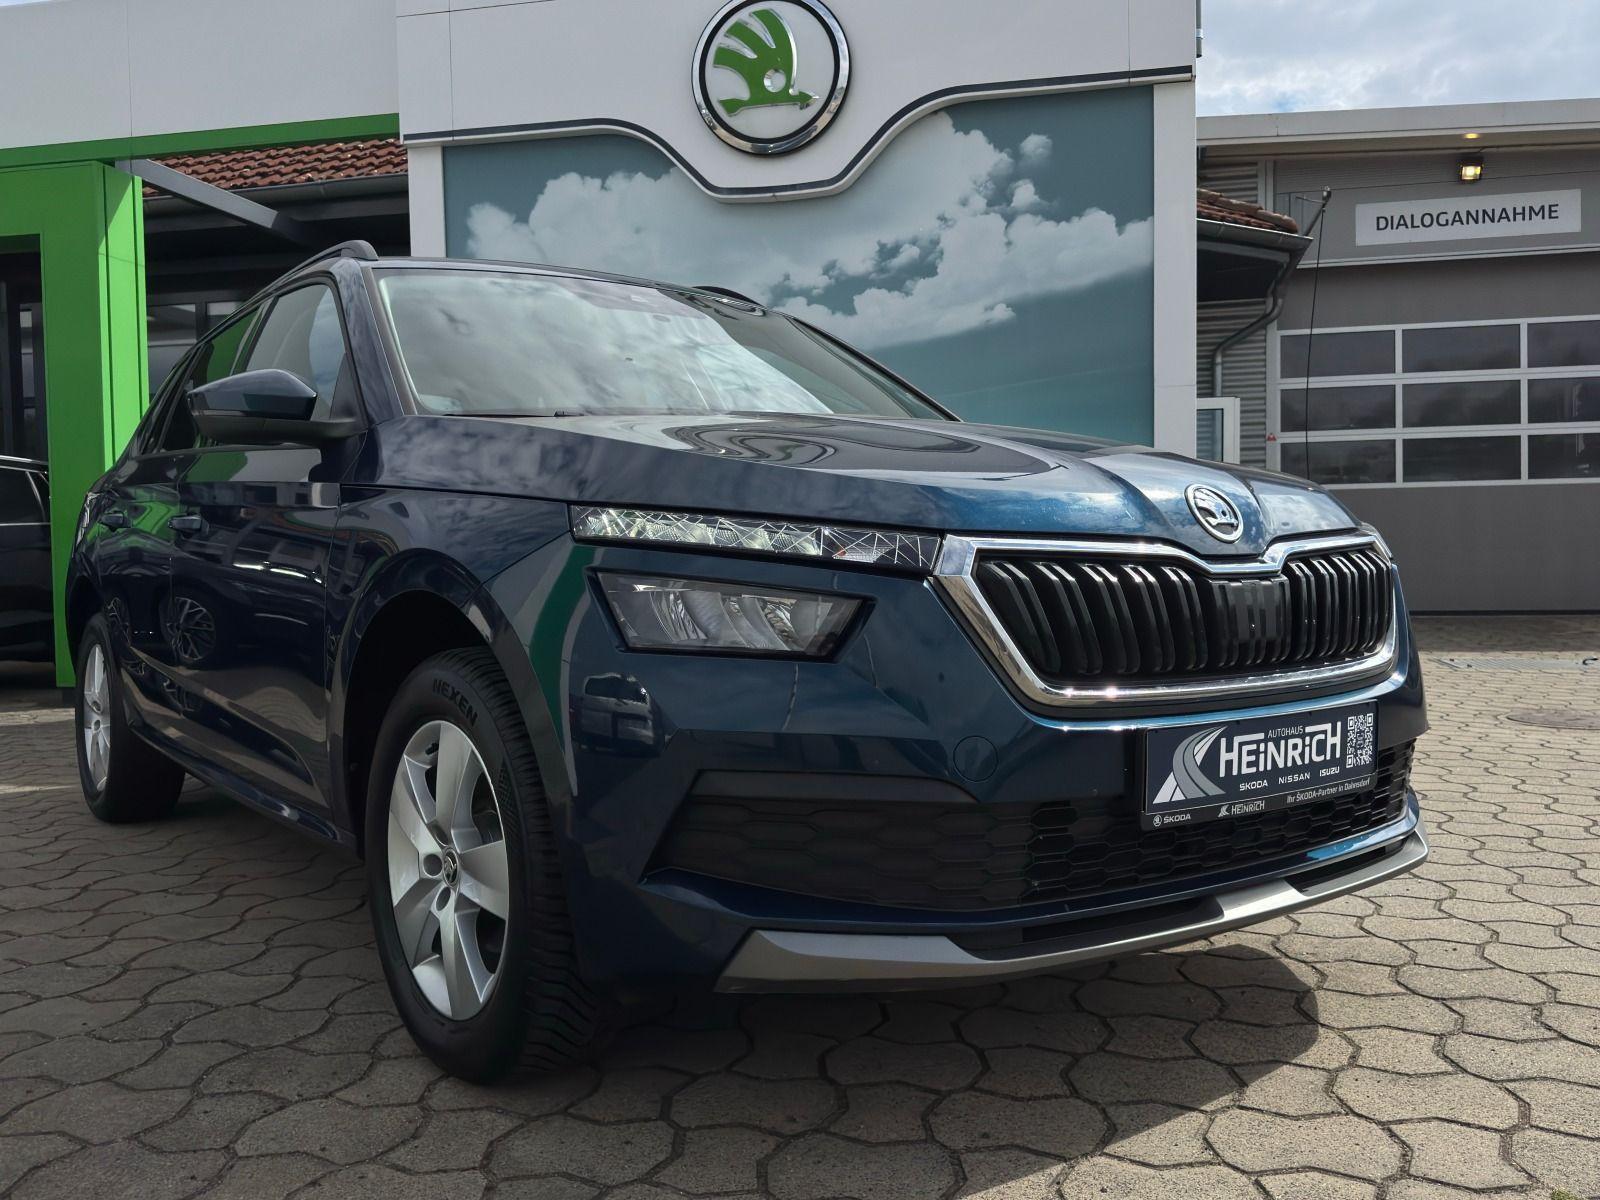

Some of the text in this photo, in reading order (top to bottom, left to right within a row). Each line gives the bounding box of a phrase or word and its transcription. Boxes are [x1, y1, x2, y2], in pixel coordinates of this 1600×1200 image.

[1376, 203, 1559, 231] DIALOGANNAHME
[433, 679, 478, 726] NEXEN
[1267, 726, 1304, 738] AUTOHAUS
[1278, 772, 1311, 785] NISSAN
[1319, 766, 1340, 777] ISUZU
[1286, 793, 1296, 803] Ihr
